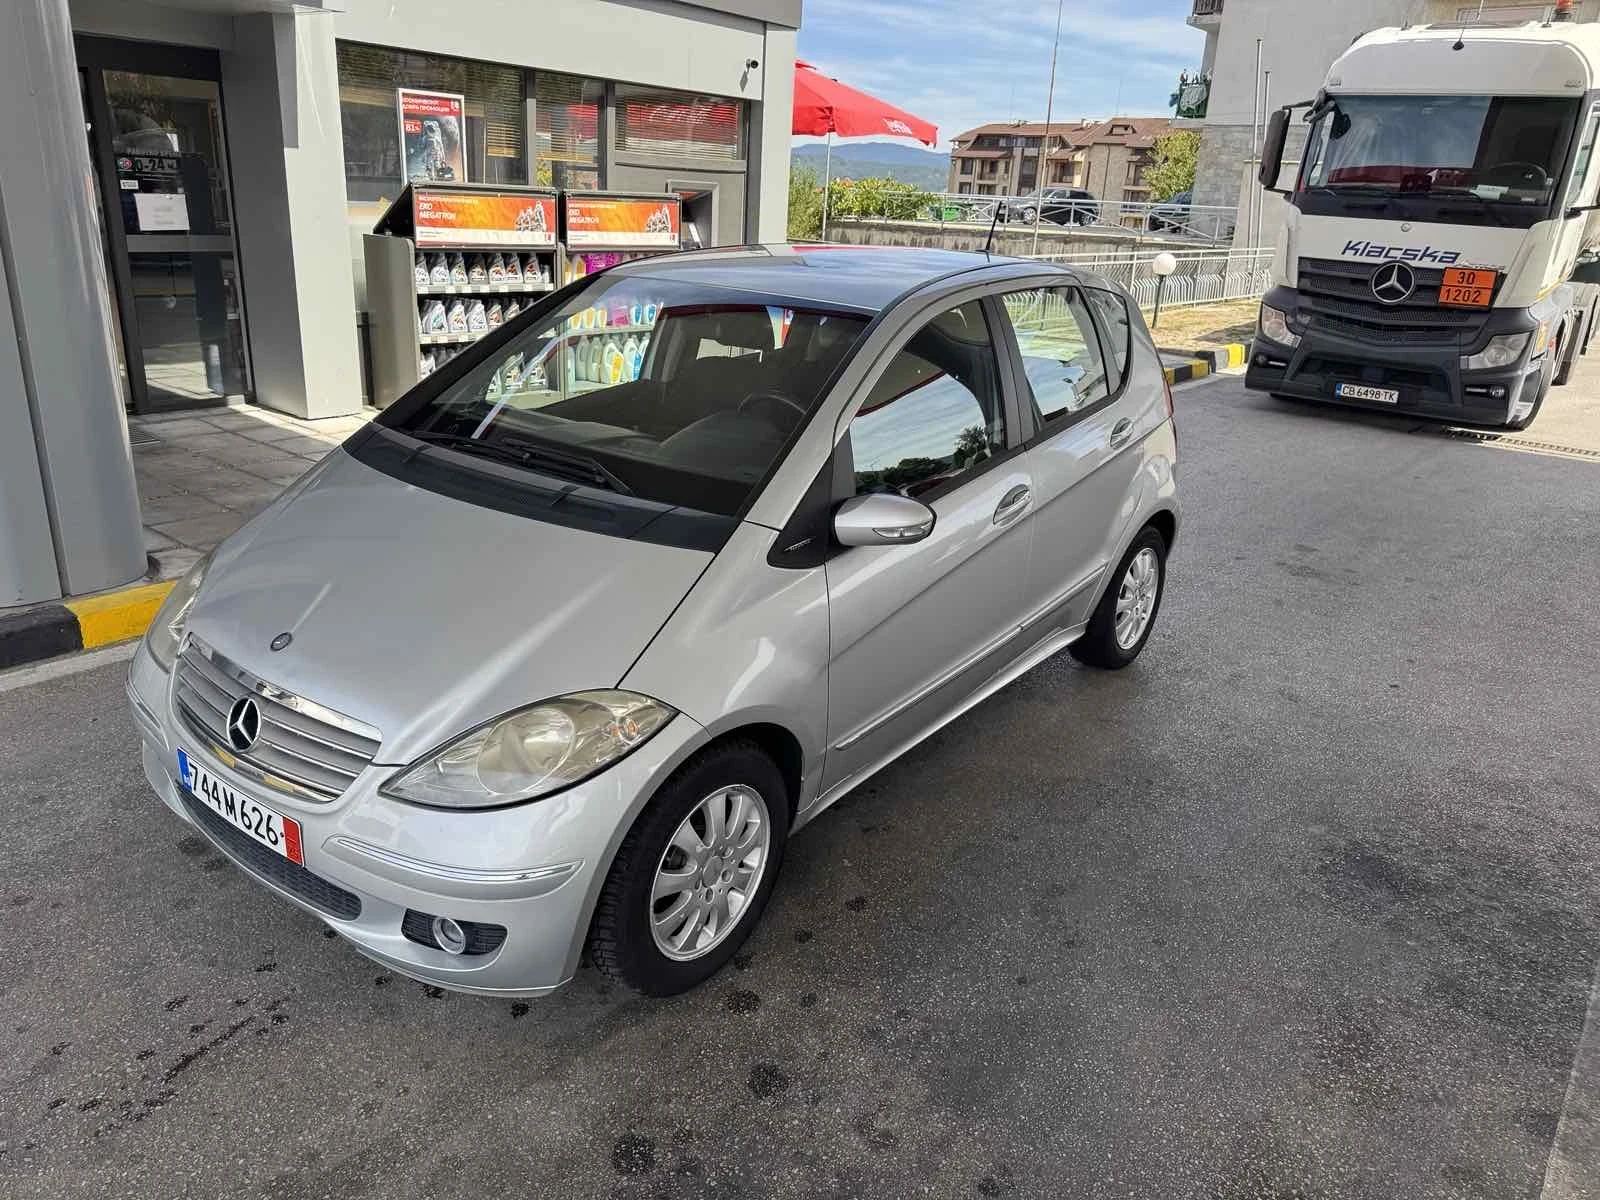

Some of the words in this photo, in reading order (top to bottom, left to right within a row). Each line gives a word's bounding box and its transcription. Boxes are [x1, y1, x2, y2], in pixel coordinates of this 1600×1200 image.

[419, 211, 457, 220] MEGATRON
[1341, 240, 1461, 264] Klacska
[1457, 271, 1476, 285] 30
[1445, 289, 1481, 303] 1202
